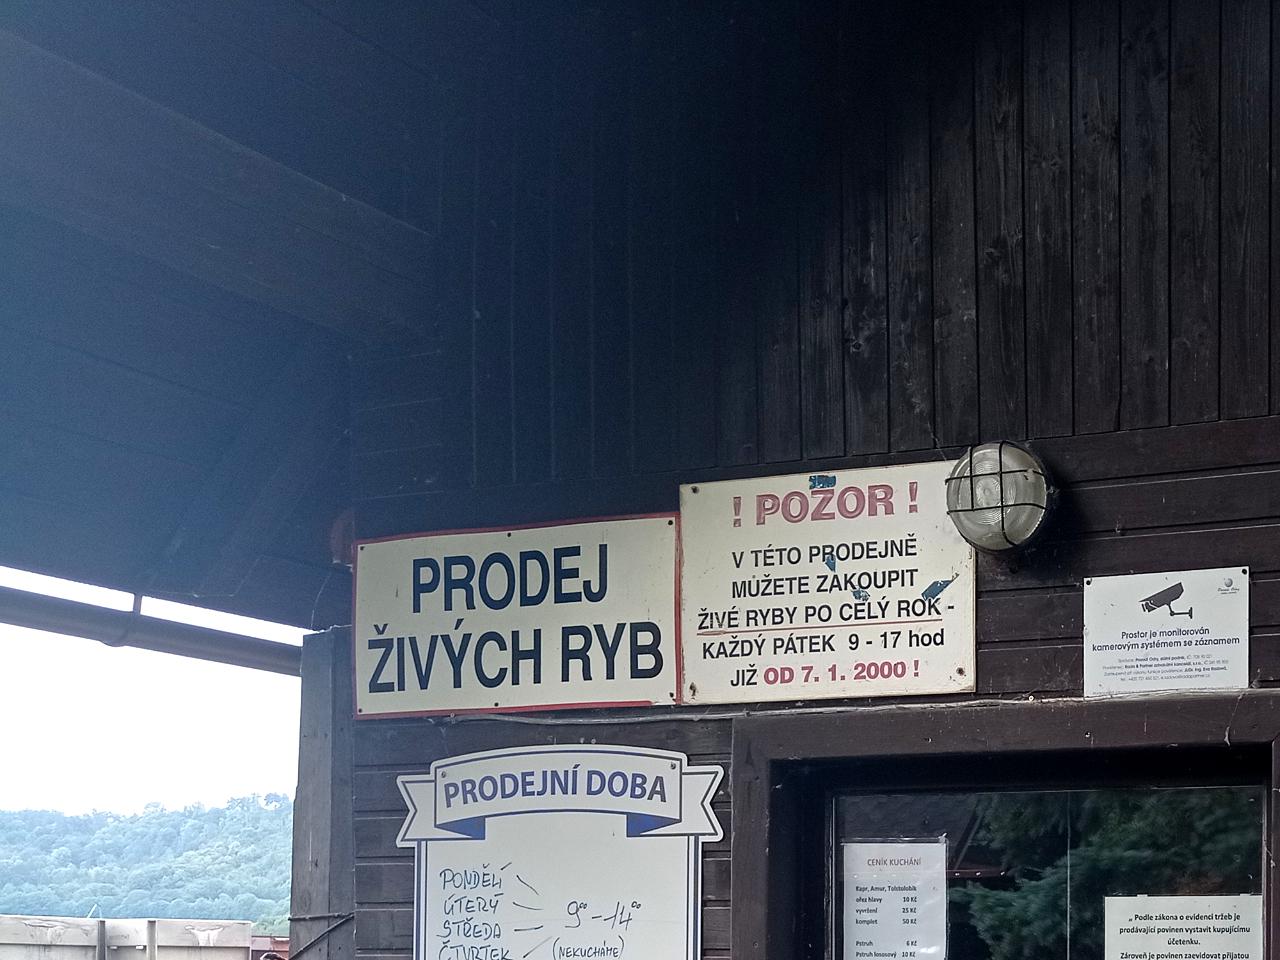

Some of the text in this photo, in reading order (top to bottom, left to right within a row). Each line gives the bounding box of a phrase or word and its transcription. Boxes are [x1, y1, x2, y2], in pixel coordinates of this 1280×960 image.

[755, 484, 895, 526] POZOR
[731, 533, 917, 568] V TÉTO PRODEJNĚ
[412, 544, 608, 613] PRODEJ
[816, 569, 919, 593] ZAKOUPIT
[698, 606, 739, 630] ŽIVÉ
[746, 606, 797, 627] RYBY
[804, 604, 832, 623] PO
[839, 596, 890, 621] CELÝ
[897, 597, 942, 618] ROK
[702, 633, 766, 659] KAŽDÝ
[773, 633, 836, 655] PÁTEK
[848, 633, 860, 650] 9
[882, 631, 902, 649] 17
[908, 628, 945, 648] hod
[1092, 641, 1139, 652] kamerovým
[1140, 638, 1182, 650] systémem
[1194, 637, 1240, 647] záznamem
[1121, 627, 1210, 640] Prostor je monitorován
[367, 618, 664, 693] ŽIVÝCH RYB
[730, 663, 758, 687] JIŽ
[763, 666, 795, 685] OD
[801, 665, 820, 683] 7.
[828, 664, 846, 681] 1.
[853, 661, 907, 680] 2000
[444, 764, 668, 809] PRODEJNÍ DOBA
[867, 857, 888, 866] CENÍK
[440, 862, 512, 890] PONDĚLÍ
[443, 892, 504, 915] ÚTERÝ
[436, 917, 502, 940] STŘEDA
[1119, 926, 1156, 934] prodávající
[1185, 926, 1212, 934] vystavit
[1212, 926, 1251, 934] kupujícímu
[1154, 913, 1178, 921] zákona
[1185, 913, 1214, 921] evidenci
[1214, 913, 1233, 921] tržeb
[1233, 914, 1241, 922] je
[1148, 952, 1155, 960] je
[1156, 952, 1183, 960] povinen
[1184, 952, 1221, 960] zaevidovat
[1222, 952, 1250, 960] přijatou
